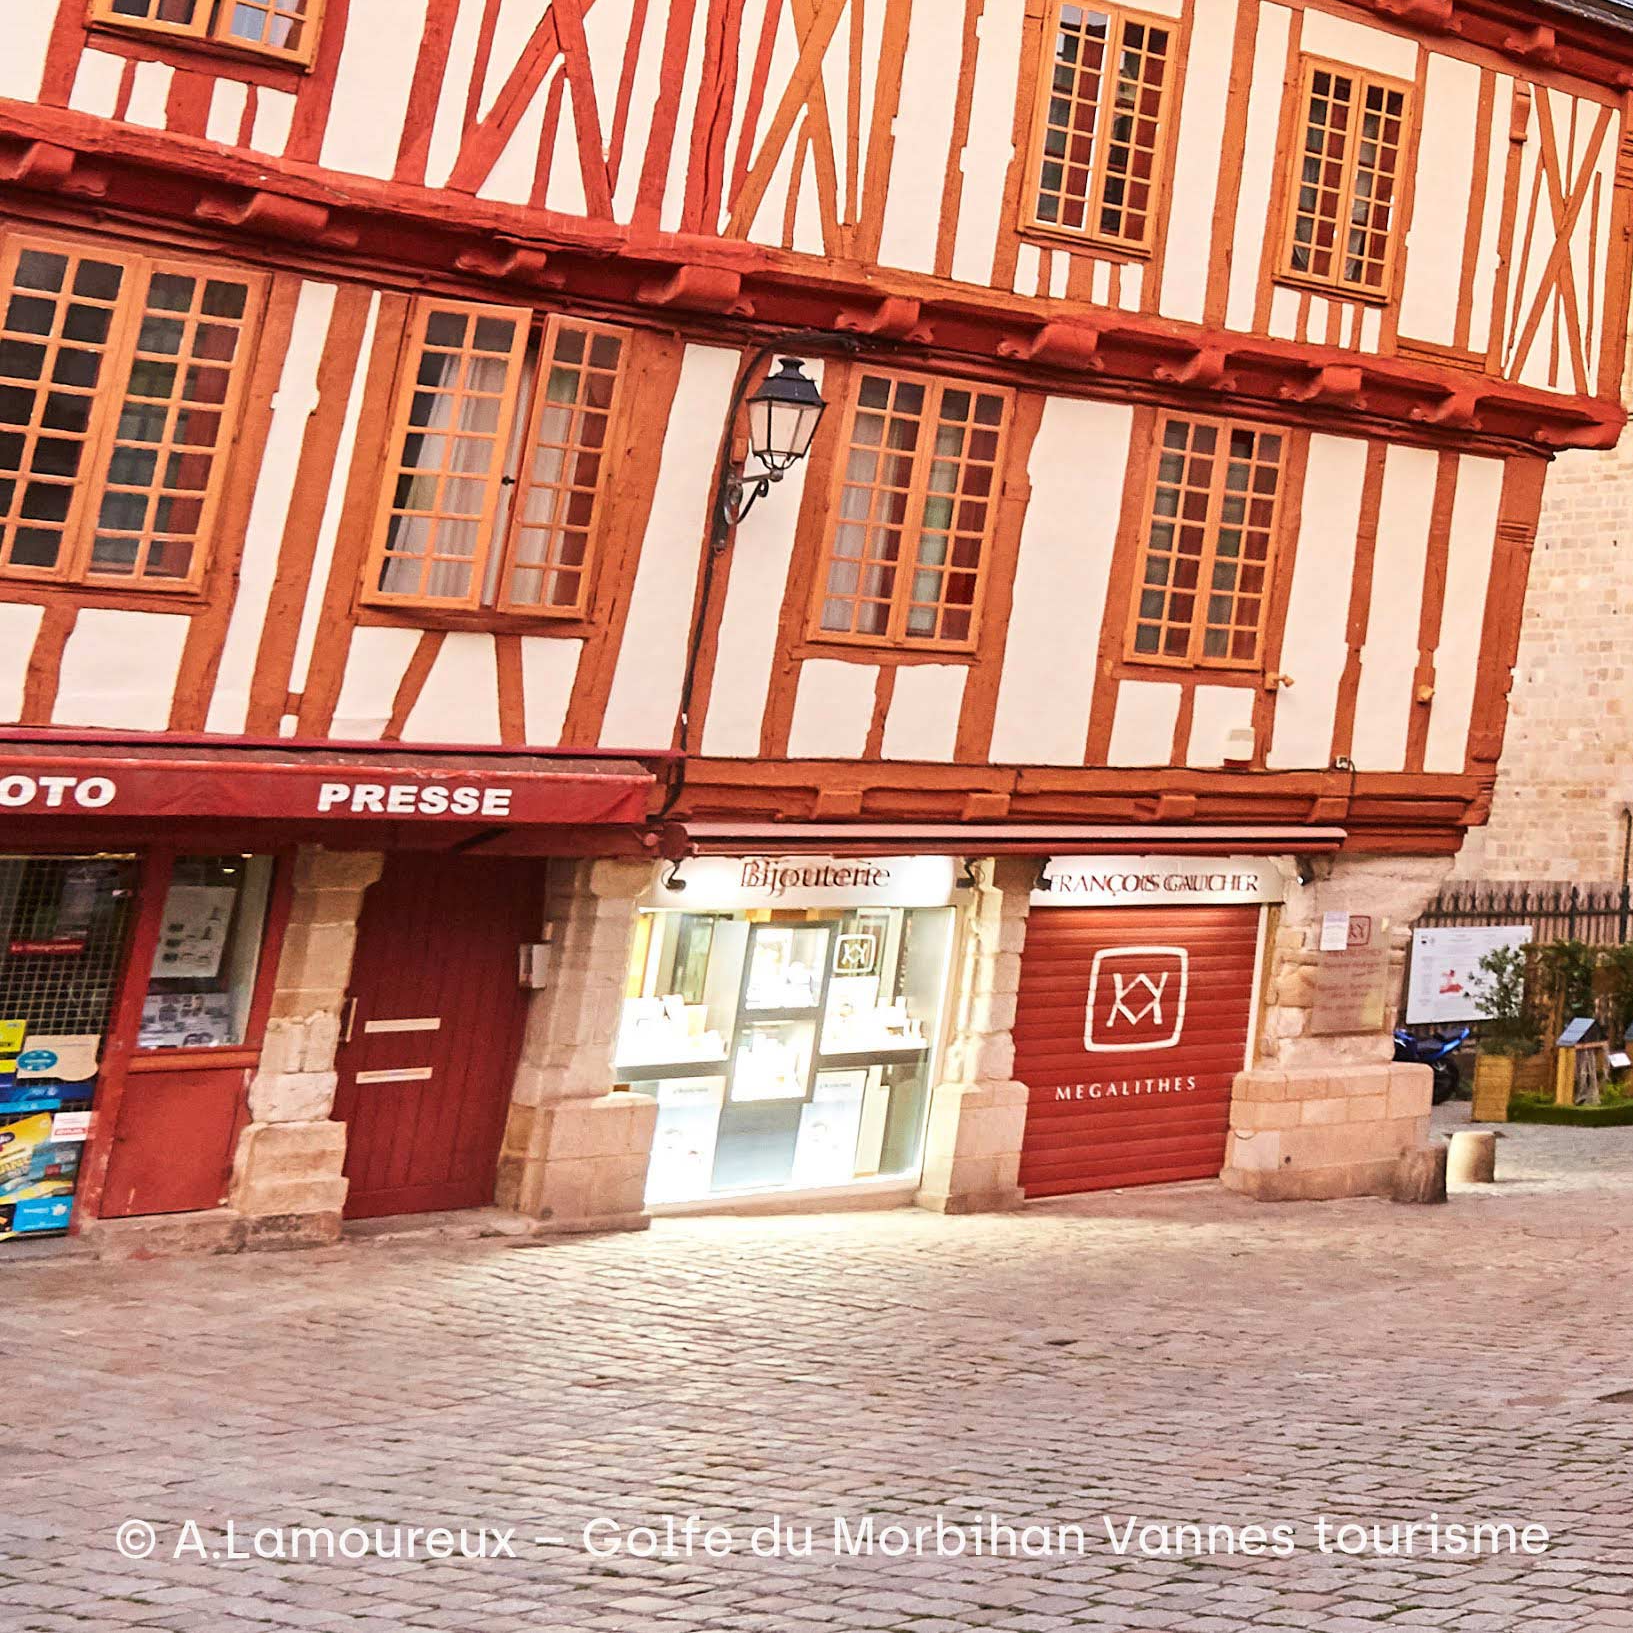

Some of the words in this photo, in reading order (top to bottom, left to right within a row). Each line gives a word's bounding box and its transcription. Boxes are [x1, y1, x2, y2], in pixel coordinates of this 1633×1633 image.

[0, 775, 116, 808] OTO
[317, 783, 513, 816] PRESSE
[740, 860, 890, 897] Bijouterie
[1050, 874, 1160, 896] FRANÇOIS
[1162, 873, 1259, 892] GAUCHER
[1055, 1075, 1196, 1101] MEGALITHES
